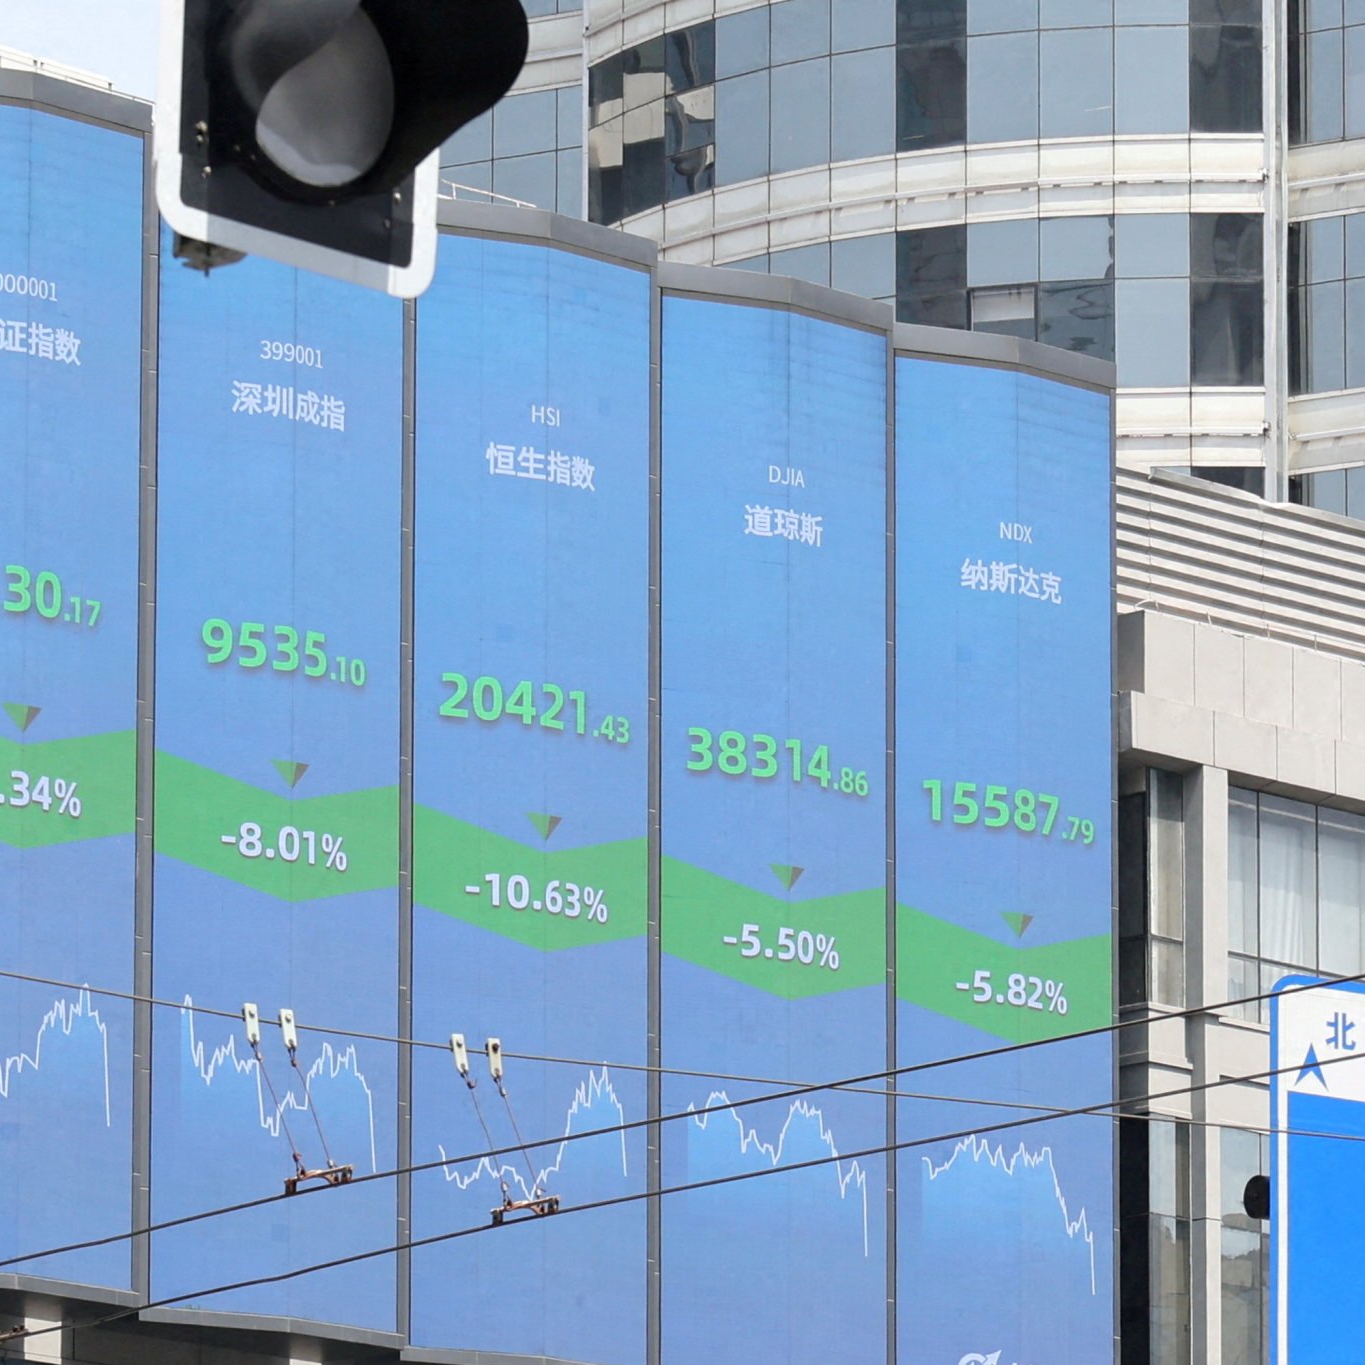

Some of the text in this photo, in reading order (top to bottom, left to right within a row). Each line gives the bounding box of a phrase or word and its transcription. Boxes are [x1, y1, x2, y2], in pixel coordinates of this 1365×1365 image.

[260, 340, 324, 369] 399001
[231, 379, 345, 432] 深圳成指
[531, 405, 560, 427] HSI
[486, 441, 596, 492] 恒生指数
[769, 465, 805, 489] DJIA
[744, 504, 824, 547] 道琼斯
[1000, 521, 1033, 544] NDX
[961, 558, 1062, 604] 纳斯达克
[201, 618, 366, 687] 9535.10
[439, 672, 631, 745] 20421.43
[686, 726, 869, 797] 38314.86
[923, 779, 1095, 844] 15587.79
[221, 822, 347, 872] -8.01%
[465, 872, 608, 924] -10.63%
[723, 924, 840, 970] -5.50%
[955, 969, 1068, 1015] -5.82%
[1325, 1012, 1356, 1051] 北
